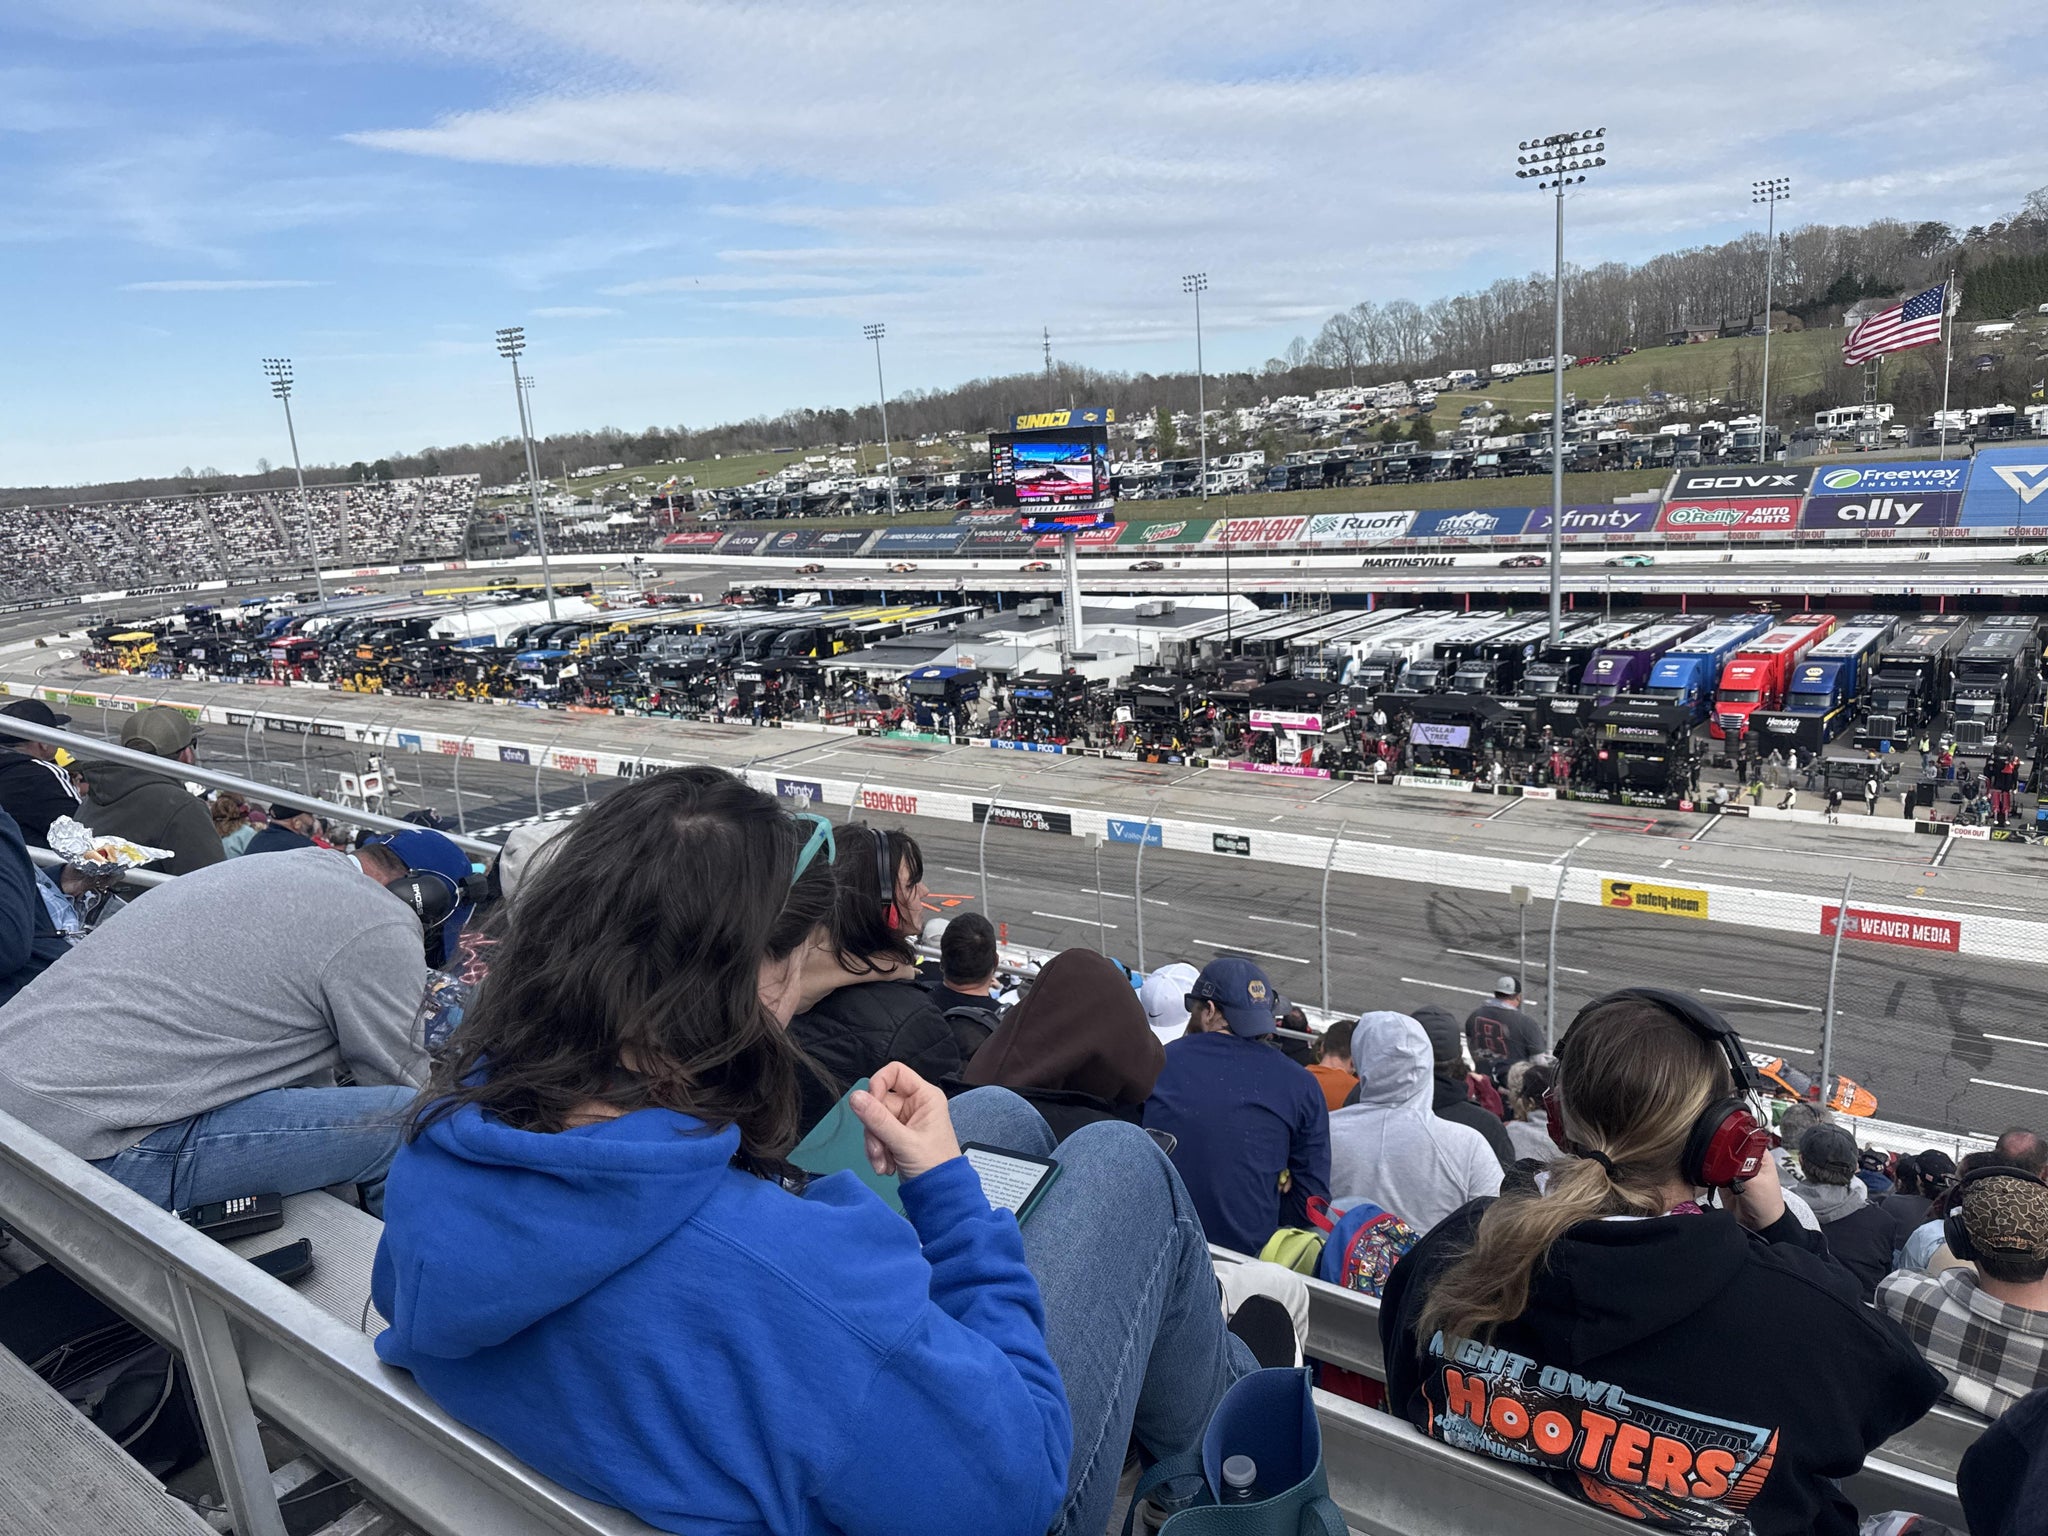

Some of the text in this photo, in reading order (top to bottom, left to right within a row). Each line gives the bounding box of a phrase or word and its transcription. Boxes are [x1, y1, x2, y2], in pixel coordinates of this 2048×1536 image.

[1016, 411, 1071, 429] SUNOCO
[1862, 468, 1960, 481] Freeway
[1686, 475, 1798, 489] GOVX
[1860, 479, 1958, 488] INSURANCE
[1667, 507, 1746, 526] O'Reilly
[1752, 507, 1790, 516] AUTO
[1837, 499, 1924, 526] ally
[1341, 515, 1408, 529] Ruoff
[1438, 516, 1499, 532] BUSCH
[1540, 510, 1642, 528] xfinity
[1744, 515, 1791, 524] PARTS
[1218, 517, 1304, 542] COOK OUT
[1335, 529, 1400, 539] MORTGAGE
[1362, 557, 1456, 568] MARTINSVILLE
[125, 584, 199, 597] MARTINSVILLE
[1766, 717, 1800, 727] Hendrick
[998, 741, 1014, 750] FICO
[1037, 744, 1055, 753] FICO
[503, 749, 525, 762] xfinity
[1413, 777, 1464, 787] DOLLAR TREE
[784, 782, 814, 797] xfinity
[863, 791, 918, 814] COOK OUT
[990, 808, 1044, 822] VIRGINIA IS FOR
[1828, 816, 1839, 825] 14
[1954, 828, 1985, 838] COOK OUT
[1993, 830, 2010, 840] 97
[1636, 892, 1699, 912] safety-kleen
[1860, 917, 1951, 944] WEAVER MEDIA
[1539, 1364, 1632, 1416] OWL
[1445, 1368, 1736, 1499] HOOTERS
[1634, 1409, 1718, 1445] NIGHT
